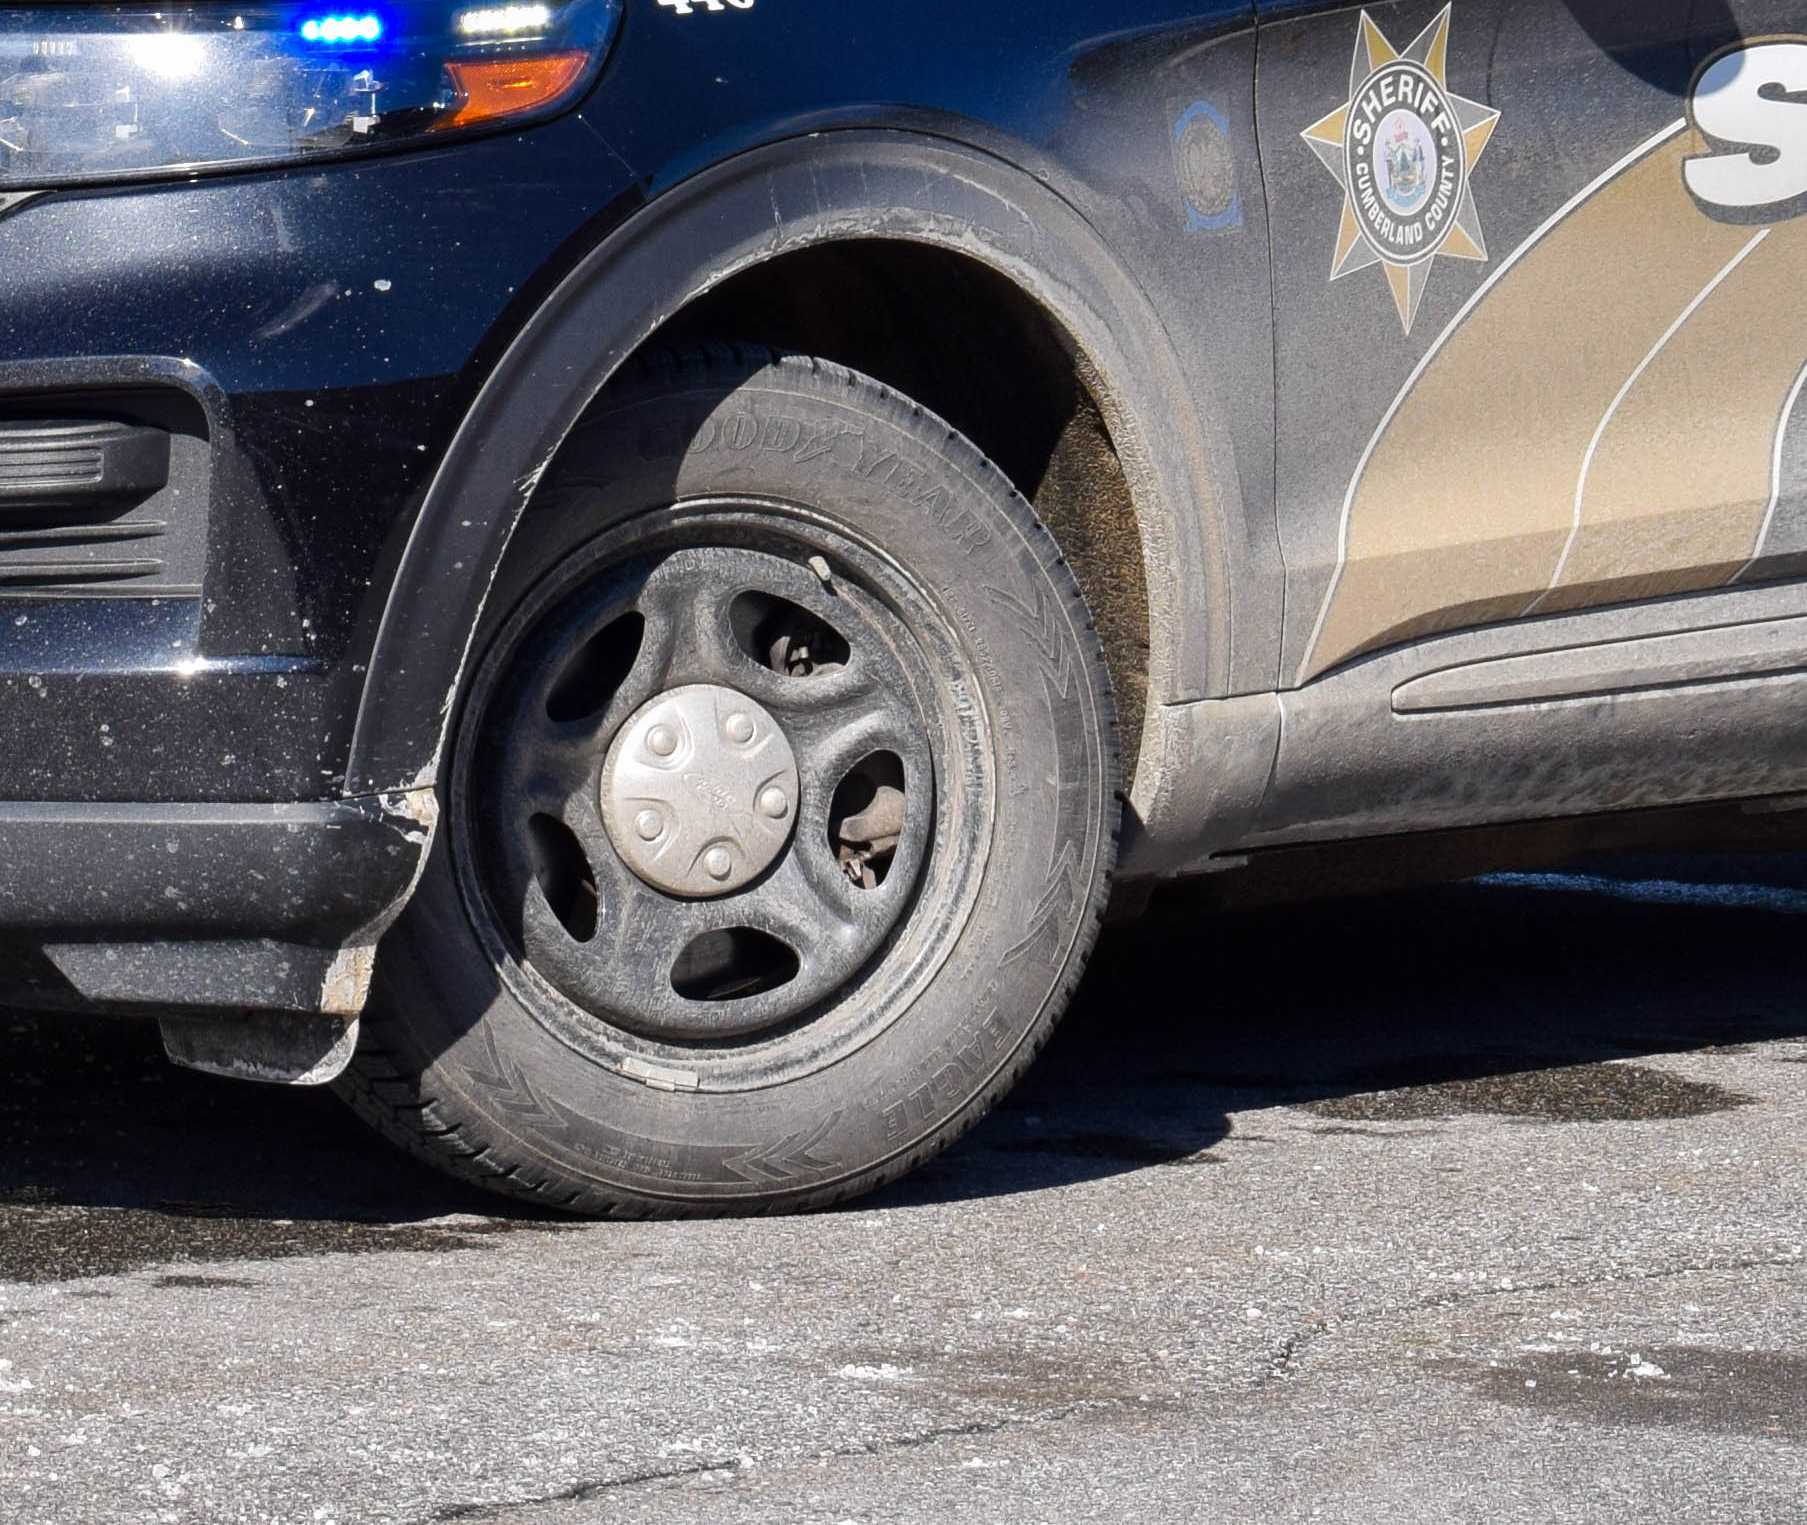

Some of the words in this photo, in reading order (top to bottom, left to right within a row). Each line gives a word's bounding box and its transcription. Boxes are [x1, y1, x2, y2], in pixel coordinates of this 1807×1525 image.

[1353, 74, 1452, 146] SHERIFF
[1356, 162, 1423, 246] CUMBERLAND
[1425, 157, 1454, 231] COUNTY
